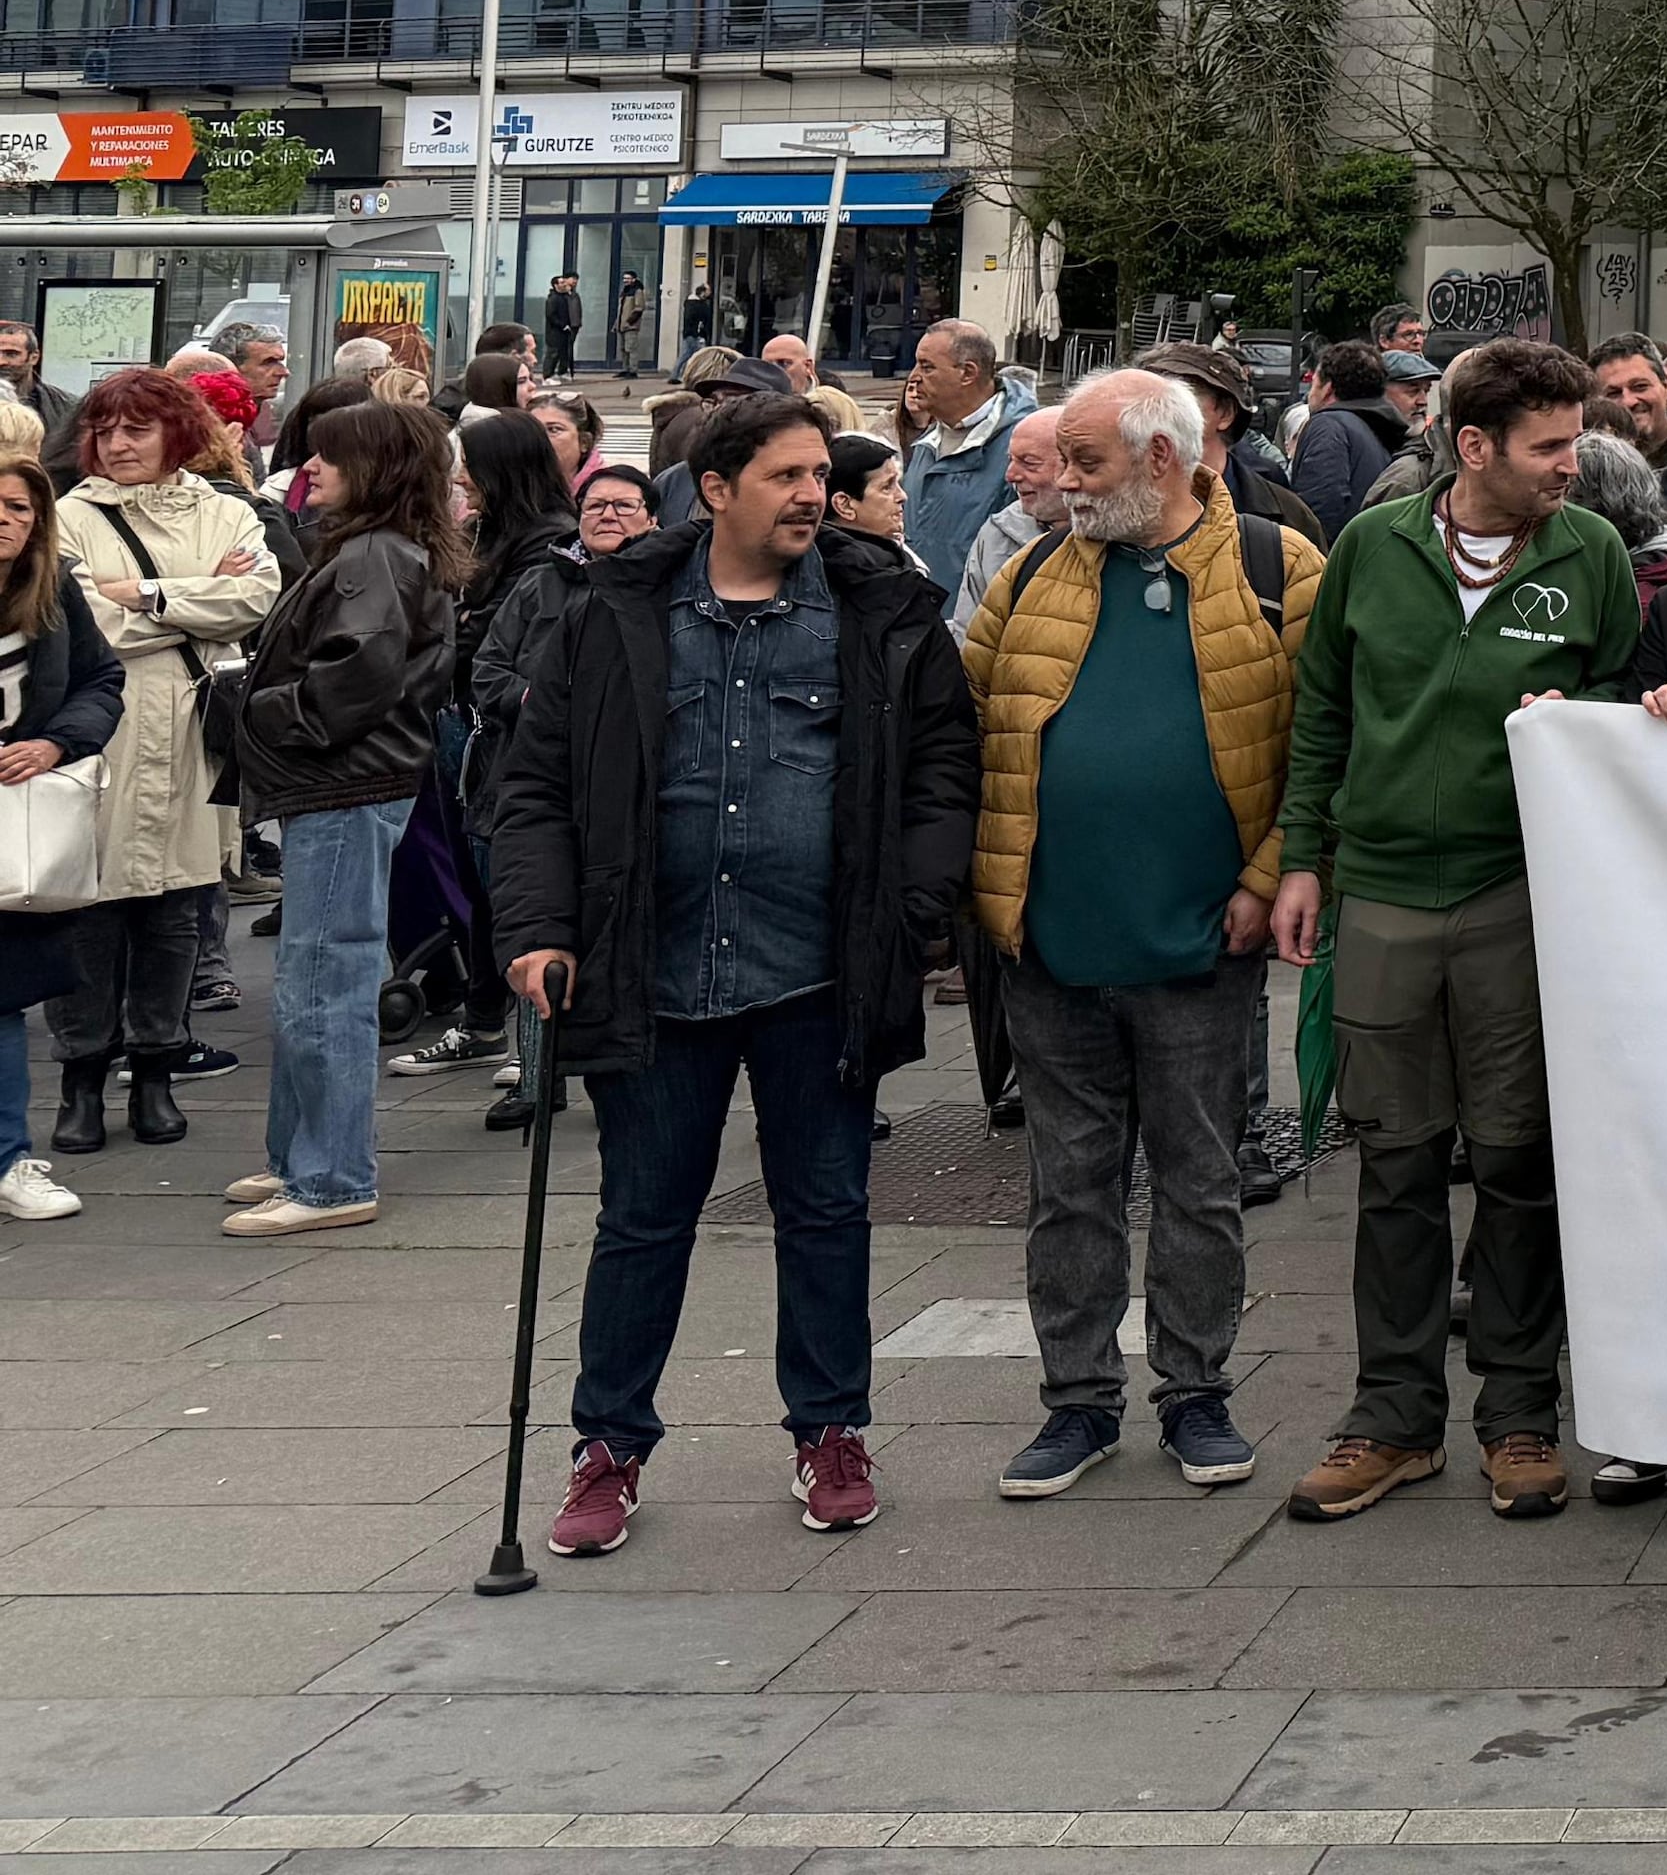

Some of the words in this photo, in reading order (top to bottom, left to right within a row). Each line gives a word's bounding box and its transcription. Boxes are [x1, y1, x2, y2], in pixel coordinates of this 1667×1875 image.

[90, 124, 173, 136] MANTENIMIENTO
[525, 138, 594, 152] GURUTZE
[610, 134, 641, 143] CENTRO
[91, 141, 97, 152] Y
[99, 140, 169, 152] REPARACIONES
[409, 141, 470, 154] EmerBask
[736, 211, 793, 224] SARDEXKA
[342, 278, 426, 325] IMPACTA
